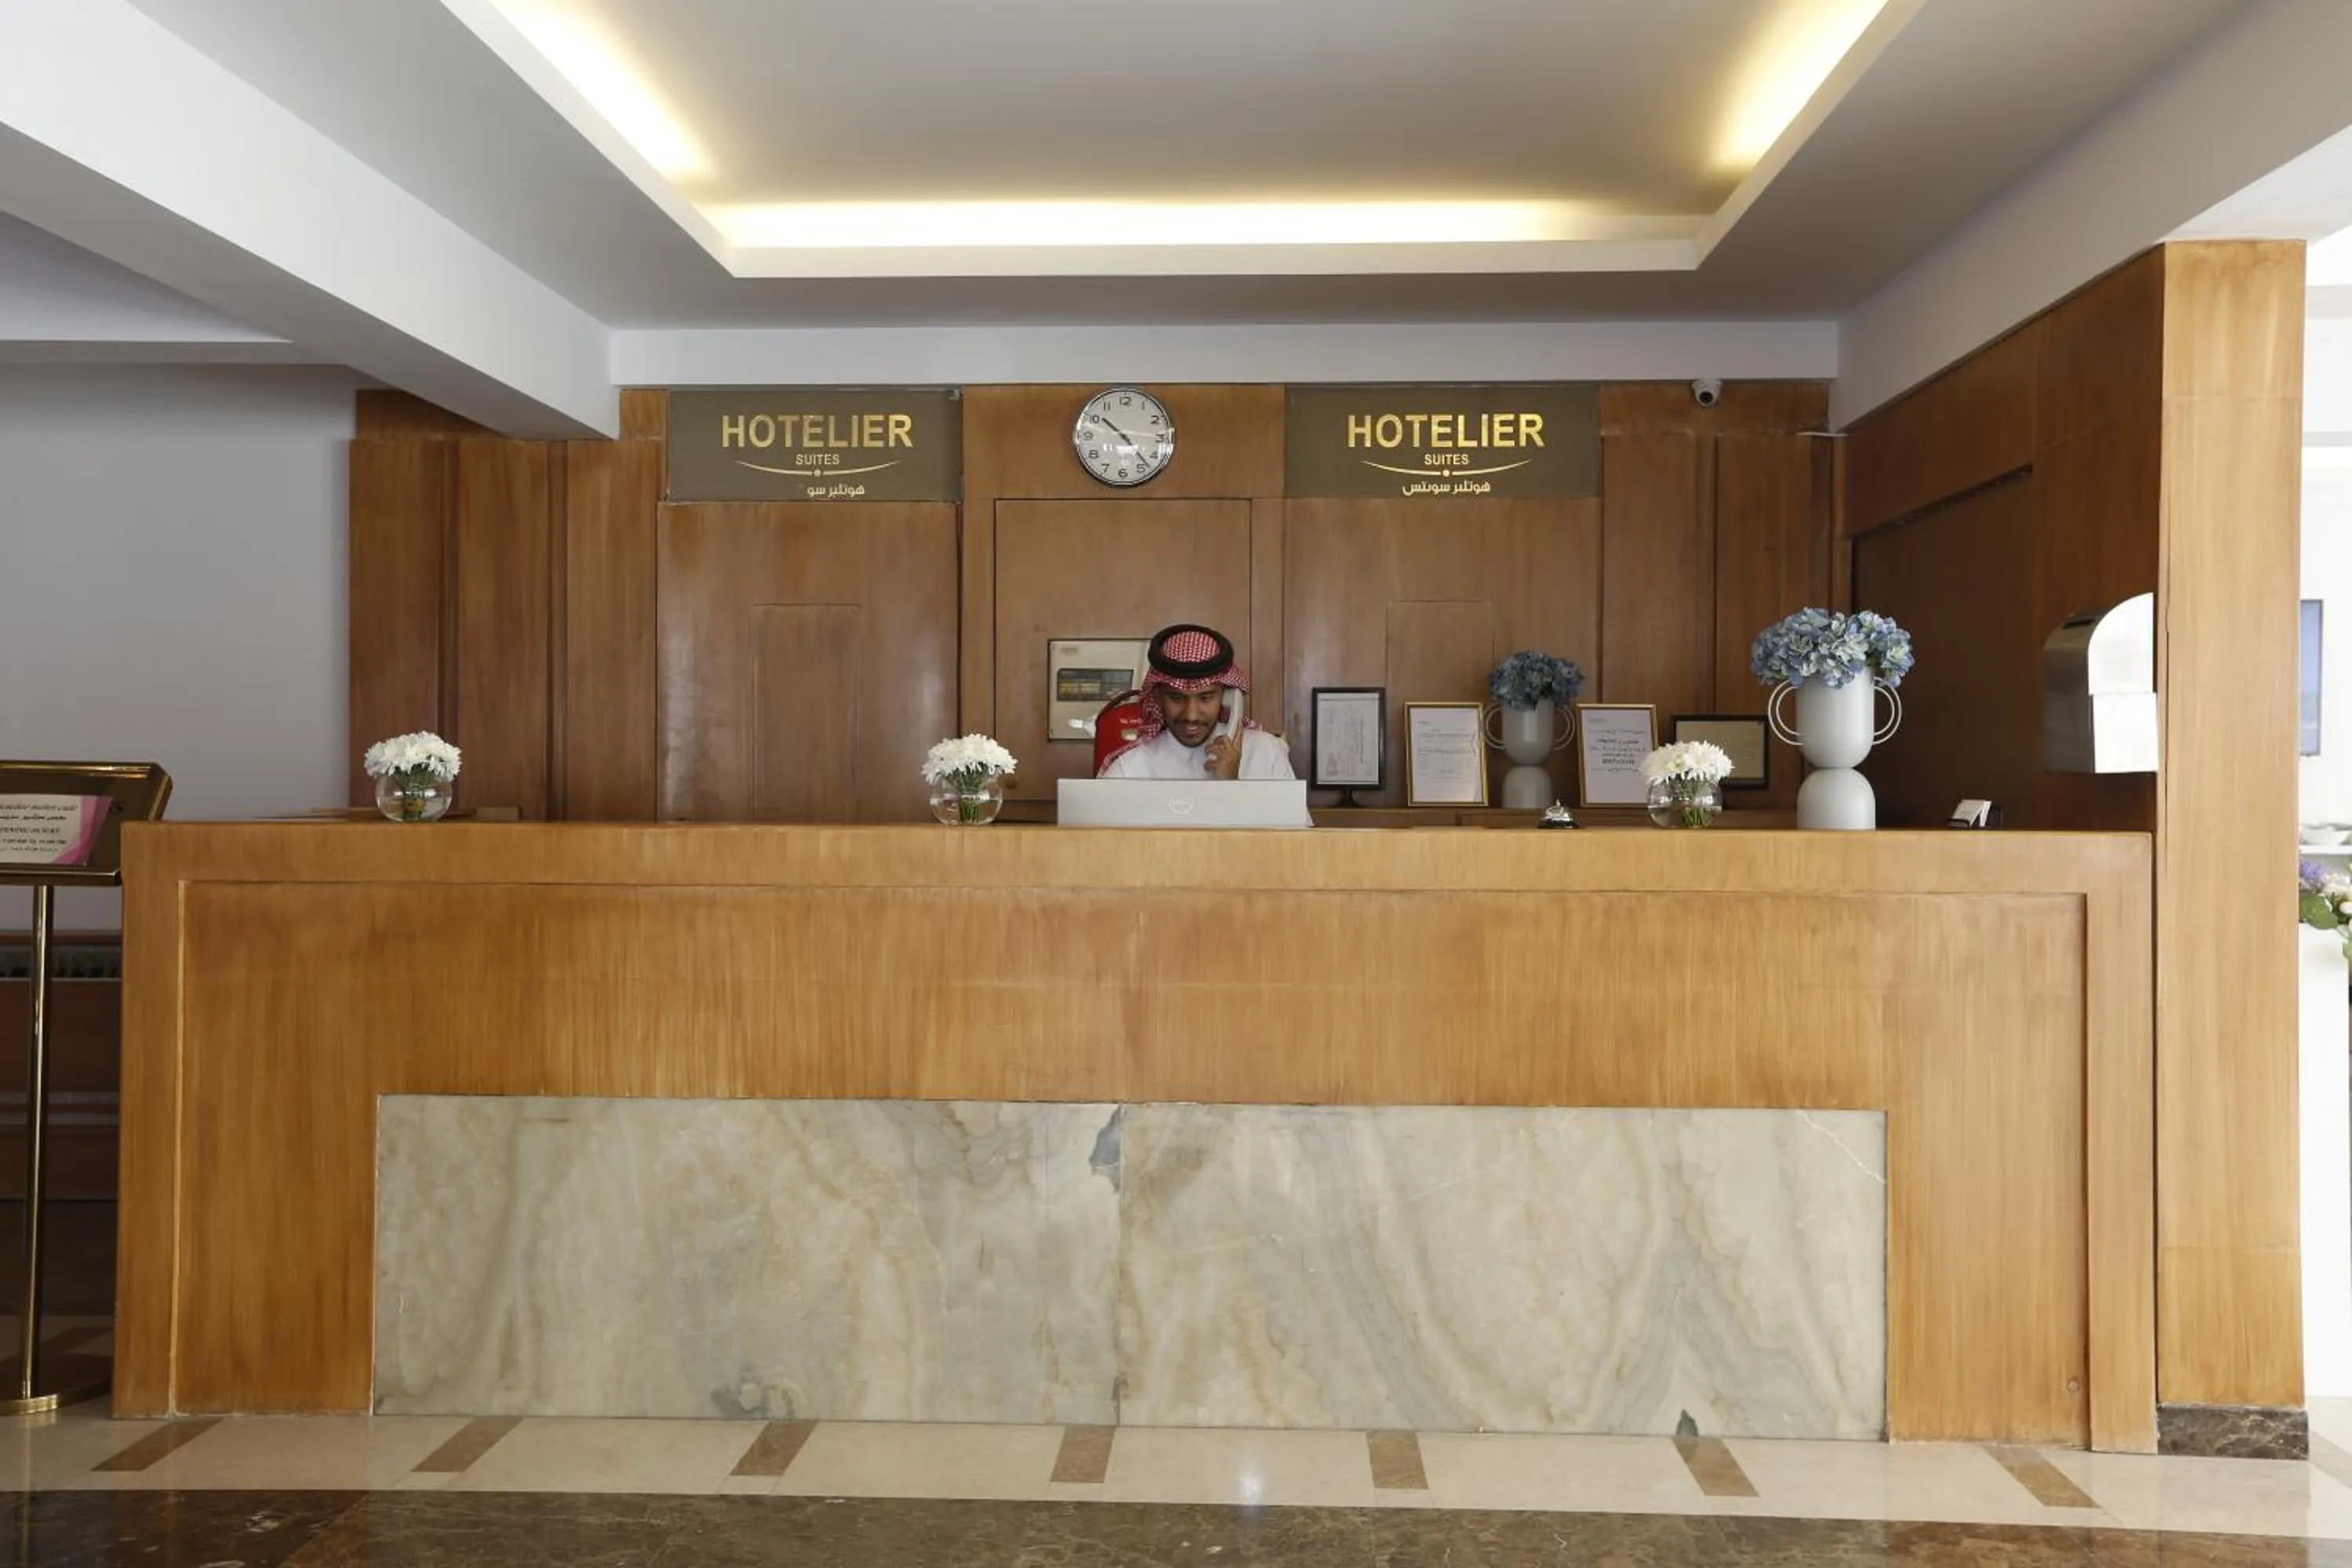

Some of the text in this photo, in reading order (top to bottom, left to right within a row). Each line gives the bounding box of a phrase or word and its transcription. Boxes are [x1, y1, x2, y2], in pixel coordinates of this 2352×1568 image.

[1103, 401, 1111, 411] 11
[1120, 396, 1131, 406] 12
[1142, 401, 1145, 410] 1
[1089, 415, 1100, 424] 10
[1150, 415, 1160, 425] 2
[721, 414, 913, 448] HOTELIER
[1347, 413, 1545, 448] HOTELIER
[1083, 431, 1094, 441] 9
[1155, 433, 1164, 443] 3
[1088, 449, 1099, 459] 8
[1149, 451, 1159, 460] 4
[796, 454, 840, 465] SUITES
[1425, 454, 1469, 465] SUITES
[1101, 463, 1110, 474] 7
[1118, 468, 1128, 478] 6
[1136, 463, 1145, 474] 5
